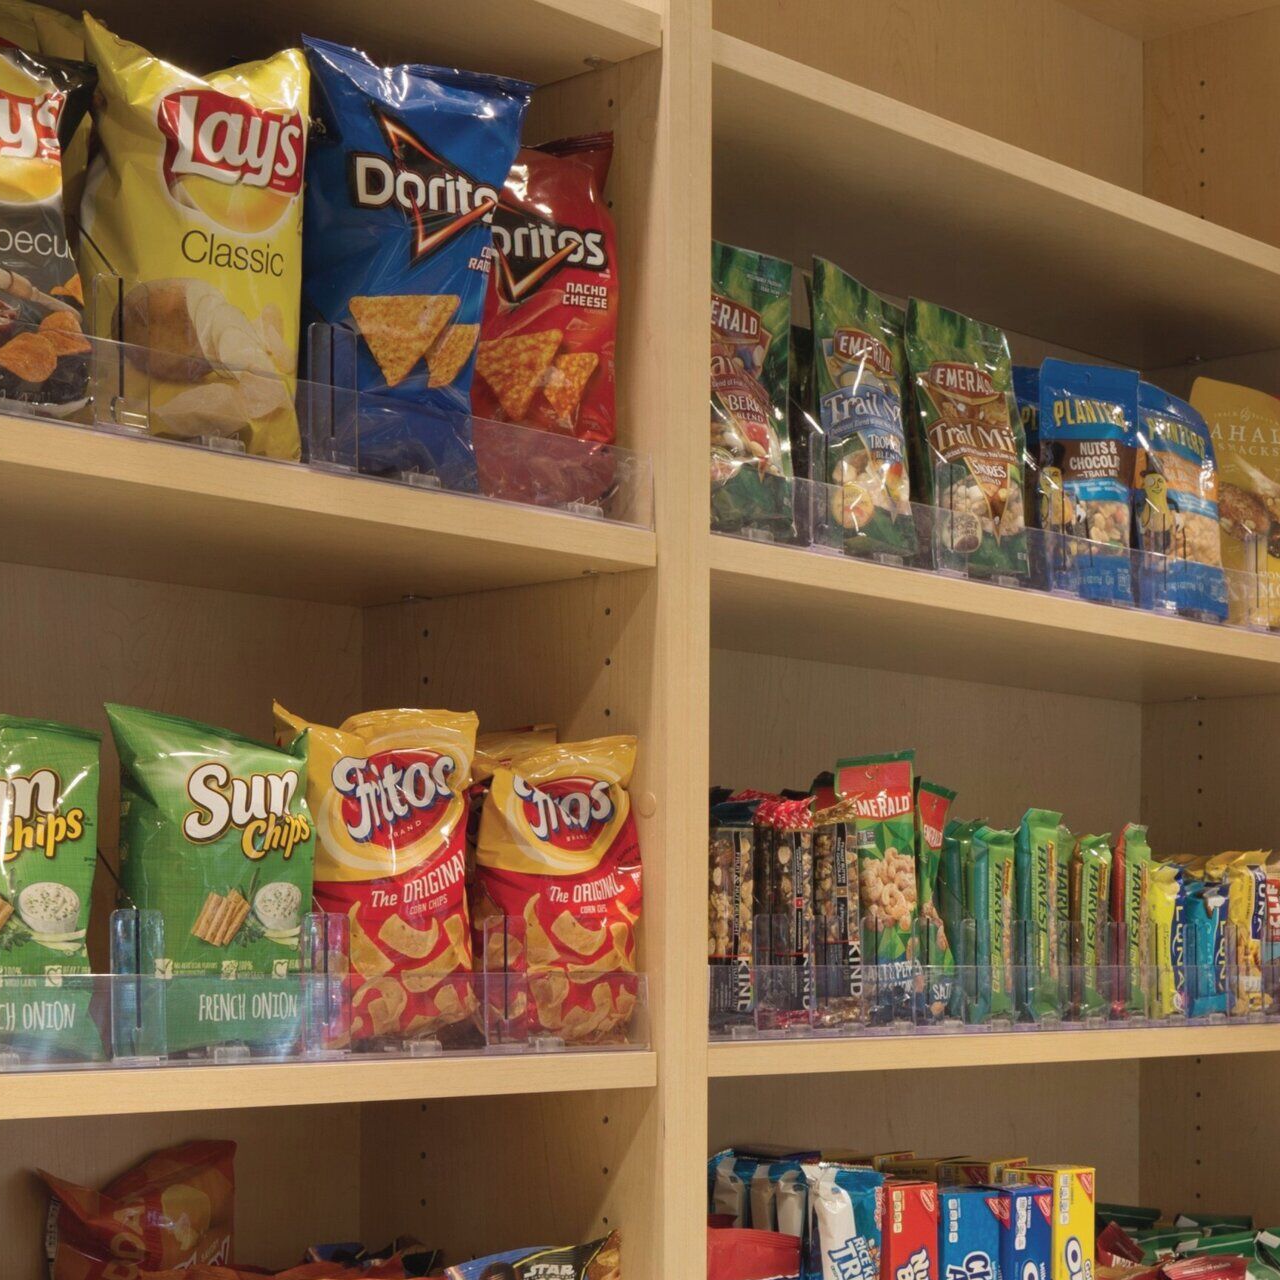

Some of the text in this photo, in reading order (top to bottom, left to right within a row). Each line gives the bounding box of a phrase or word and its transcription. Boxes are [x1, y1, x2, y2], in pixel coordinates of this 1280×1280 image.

[172, 96, 301, 186] Lay's
[181, 230, 285, 277] Classic
[562, 294, 608, 309] CHEESE
[567, 282, 608, 297] NACHO
[824, 393, 877, 425] Trail
[929, 422, 974, 451] Trail
[1080, 442, 1108, 455] NUTS
[184, 762, 301, 843] Sun
[331, 754, 456, 843] Fritos
[241, 813, 310, 860] Chips
[371, 889, 398, 908] The
[992, 854, 1004, 952] HARVEST
[1037, 845, 1048, 934] HARVEST
[1086, 864, 1099, 951] HARVEST
[1175, 905, 1186, 986] LUNA
[23, 1001, 76, 1030] ONION
[198, 992, 298, 1022] FRENCH ONION
[851, 1236, 870, 1267] RICE
[524, 1262, 575, 1277] STAR
